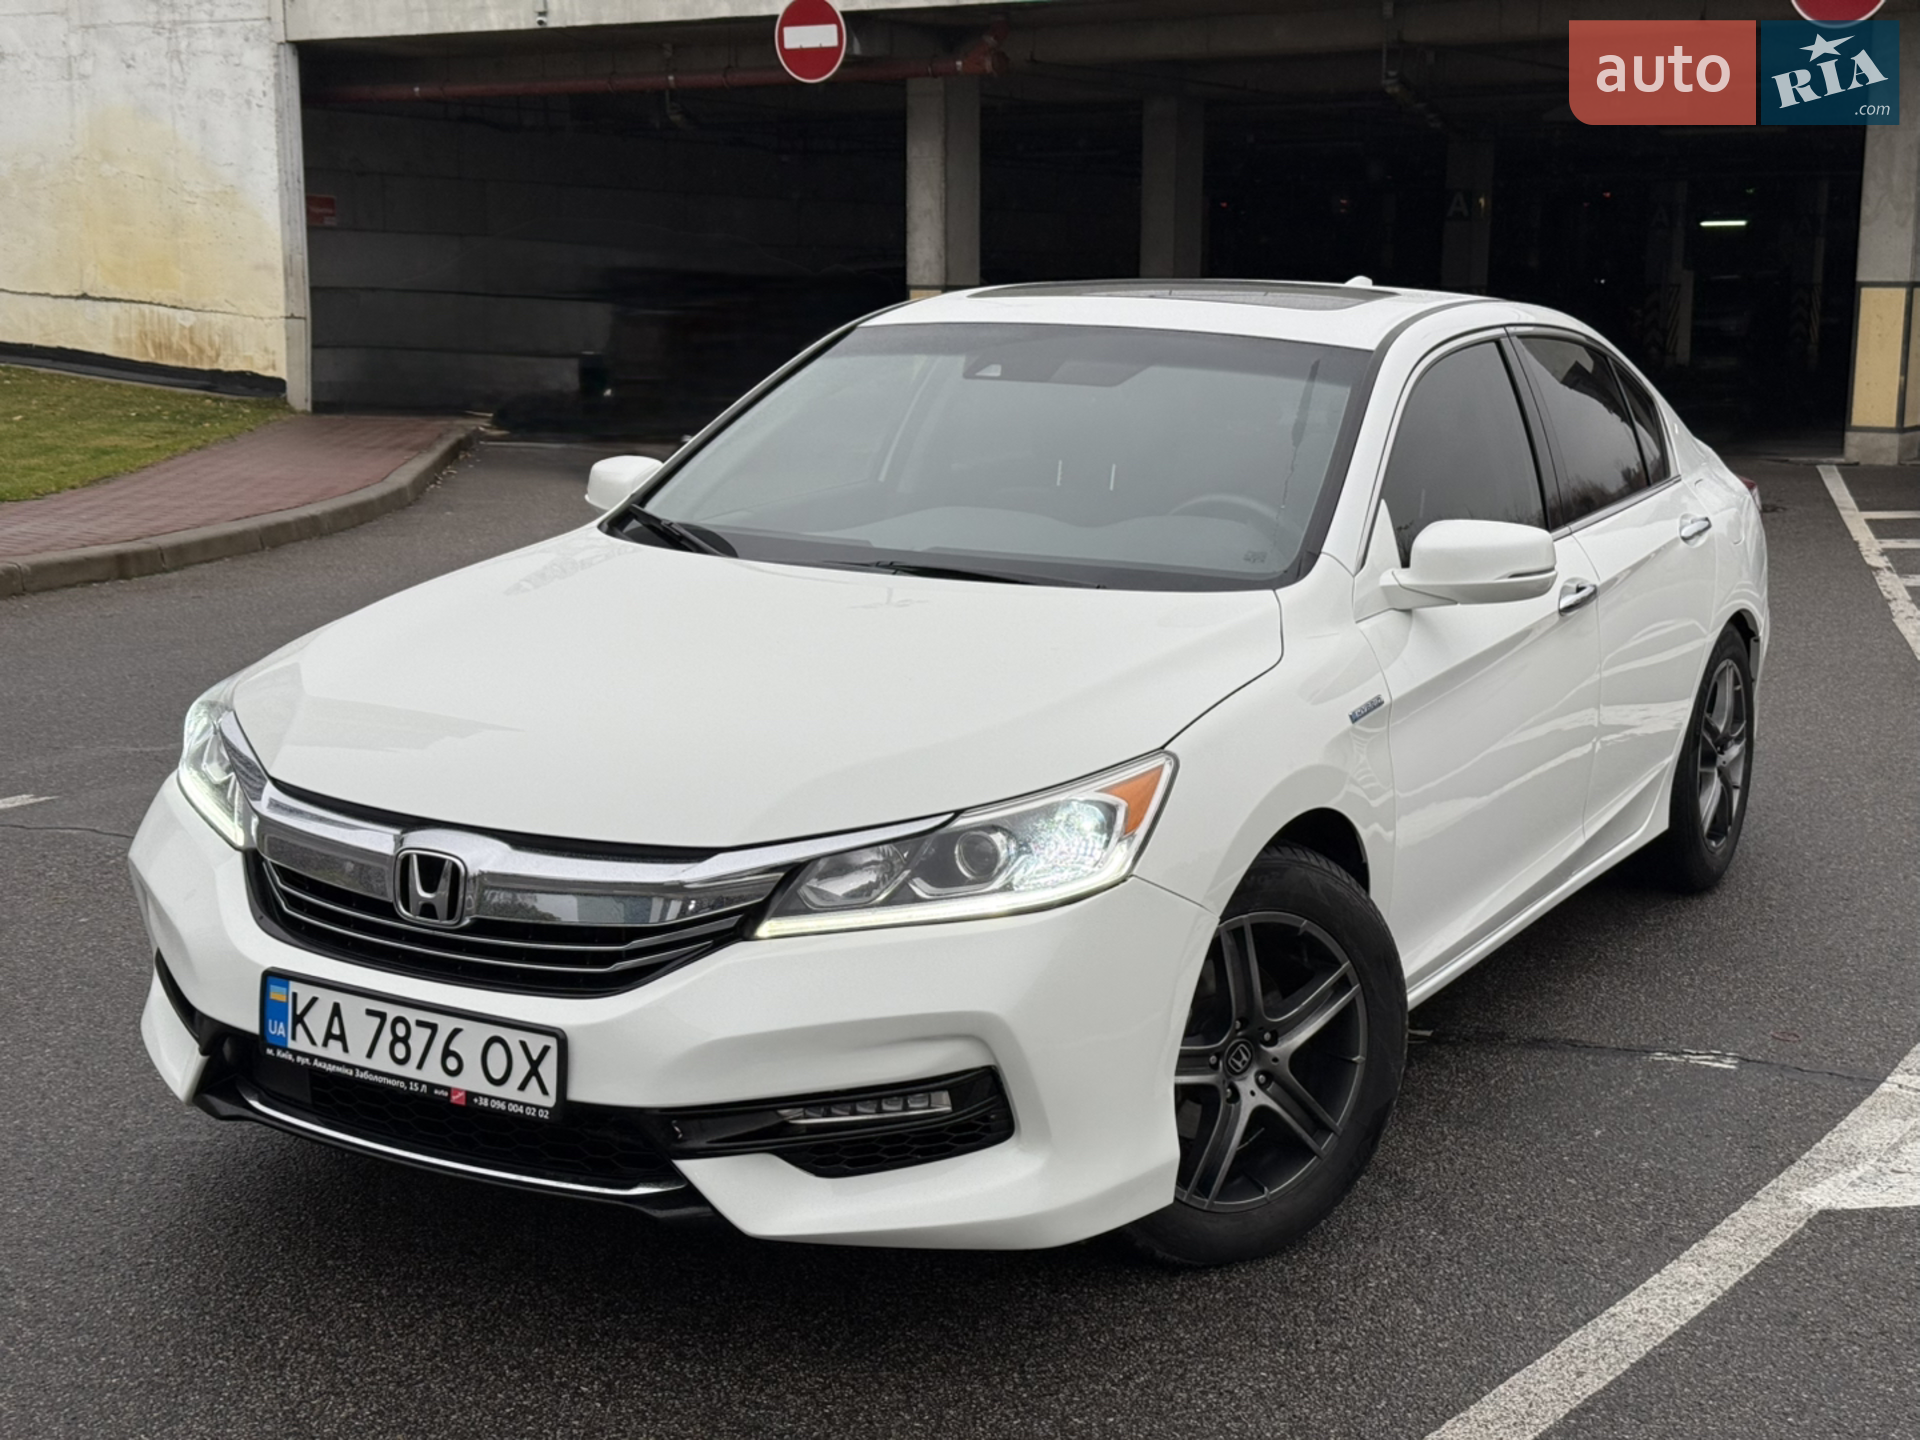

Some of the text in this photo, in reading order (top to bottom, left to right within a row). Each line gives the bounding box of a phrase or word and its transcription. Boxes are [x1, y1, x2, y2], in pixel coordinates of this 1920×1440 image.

[268, 1019, 286, 1038] UA
[291, 991, 552, 1096] KA 7876 OX
[276, 1049, 294, 1063] Київ,
[296, 1055, 312, 1066] вул.
[313, 1058, 353, 1076] Академіка
[355, 1068, 407, 1090] Заболотного,
[409, 1081, 419, 1092] 15
[473, 1096, 489, 1107] +38
[490, 1099, 507, 1111] 096
[507, 1102, 524, 1114] 004
[525, 1106, 537, 1116] 02
[538, 1109, 550, 1119] 02
